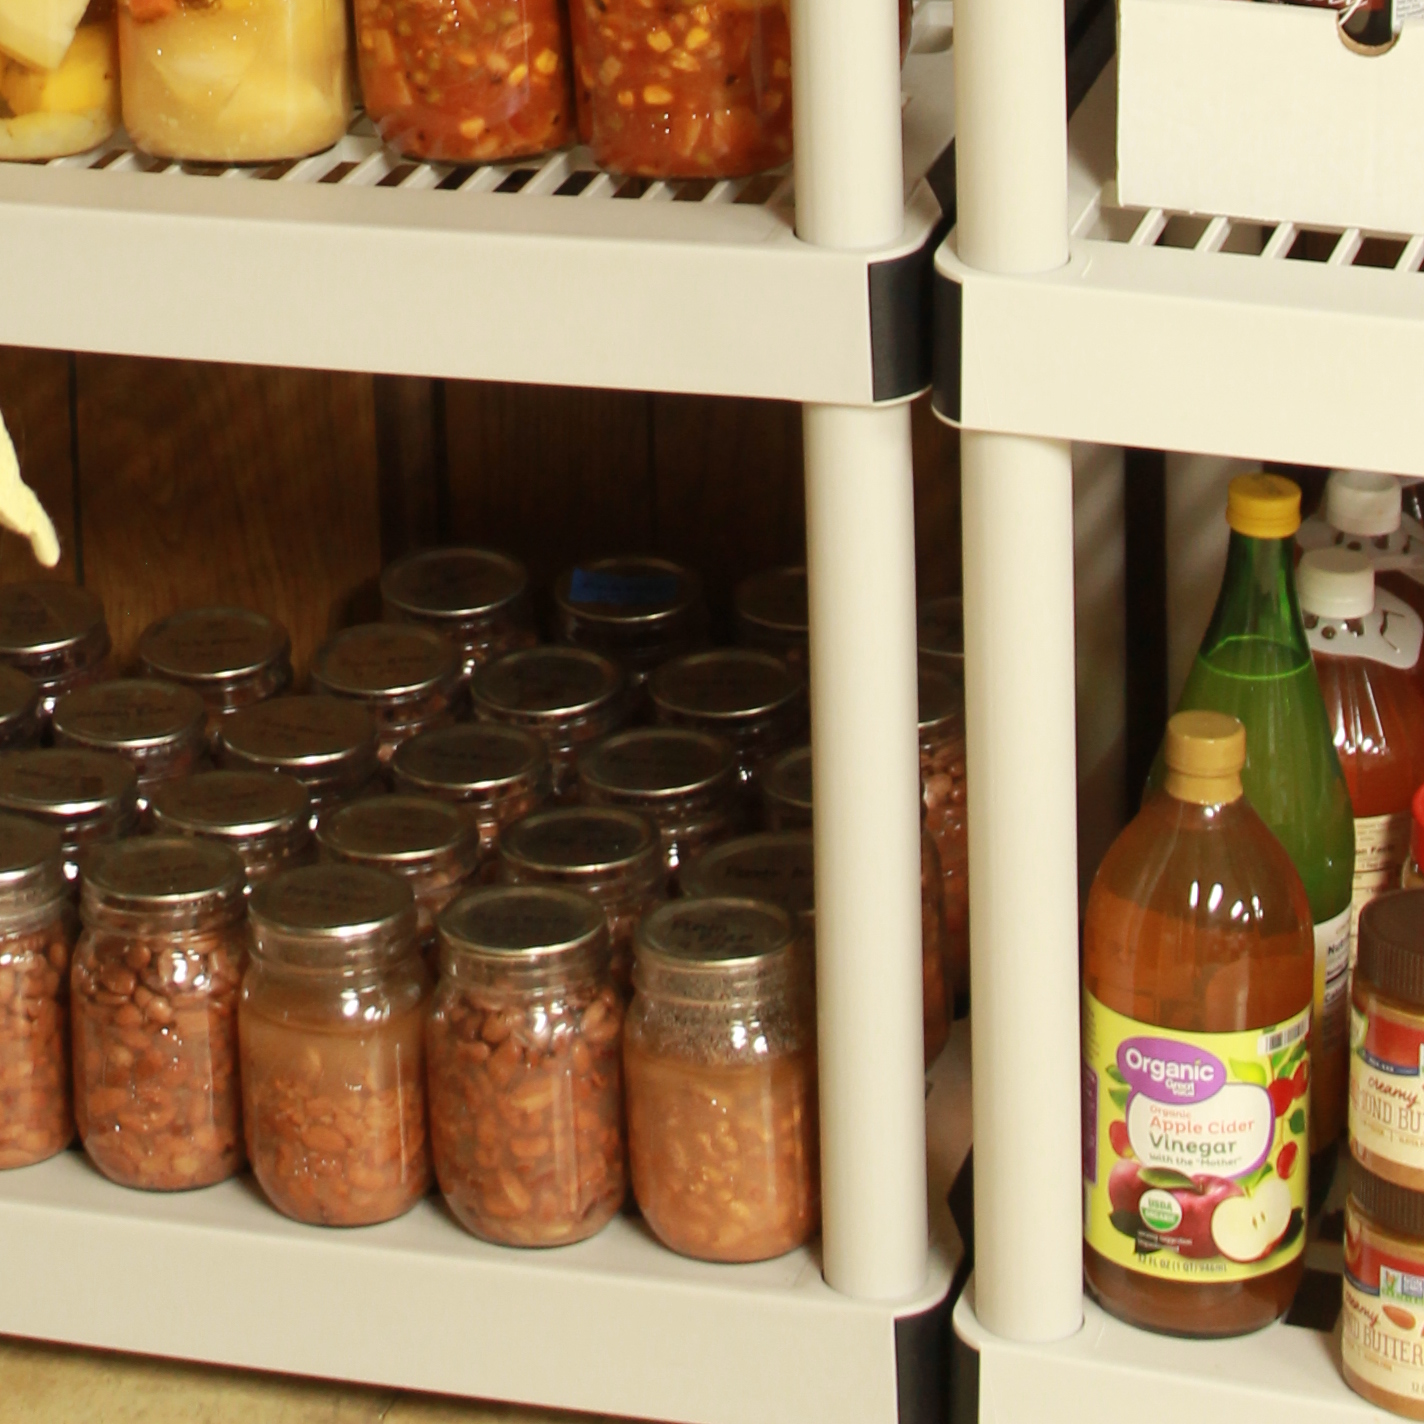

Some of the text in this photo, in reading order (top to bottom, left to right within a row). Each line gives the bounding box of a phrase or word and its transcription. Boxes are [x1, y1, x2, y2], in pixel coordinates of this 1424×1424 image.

[1126, 1047, 1214, 1082] Organic
[1150, 1105, 1191, 1119] Organic
[1399, 1106, 1424, 1133] BU
[1150, 1116, 1255, 1136] Apple Cider
[1150, 1133, 1237, 1158] Vinegar
[1149, 1153, 1173, 1165] with
[1176, 1155, 1193, 1166] the
